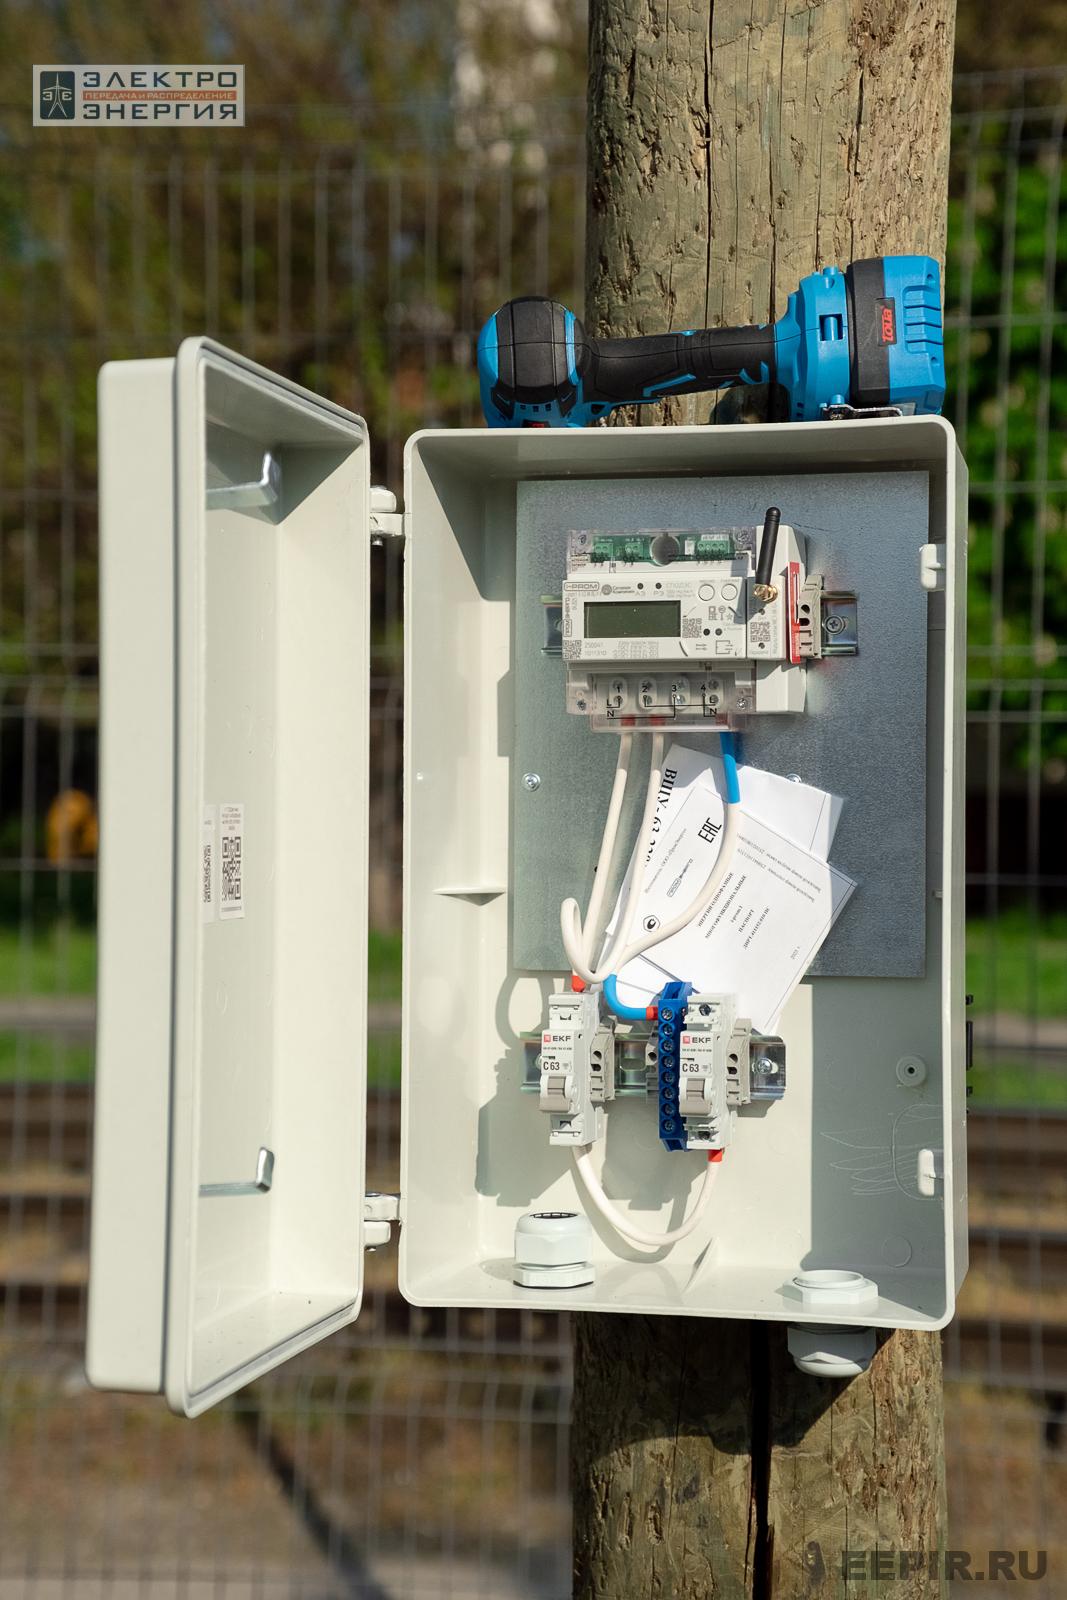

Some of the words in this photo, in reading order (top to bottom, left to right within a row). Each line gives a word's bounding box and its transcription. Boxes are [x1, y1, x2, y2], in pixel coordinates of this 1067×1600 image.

[543, 1061, 549, 1071] C
[550, 1061, 560, 1071] 63
[682, 1063, 688, 1072] C
[689, 1063, 699, 1073] 63
